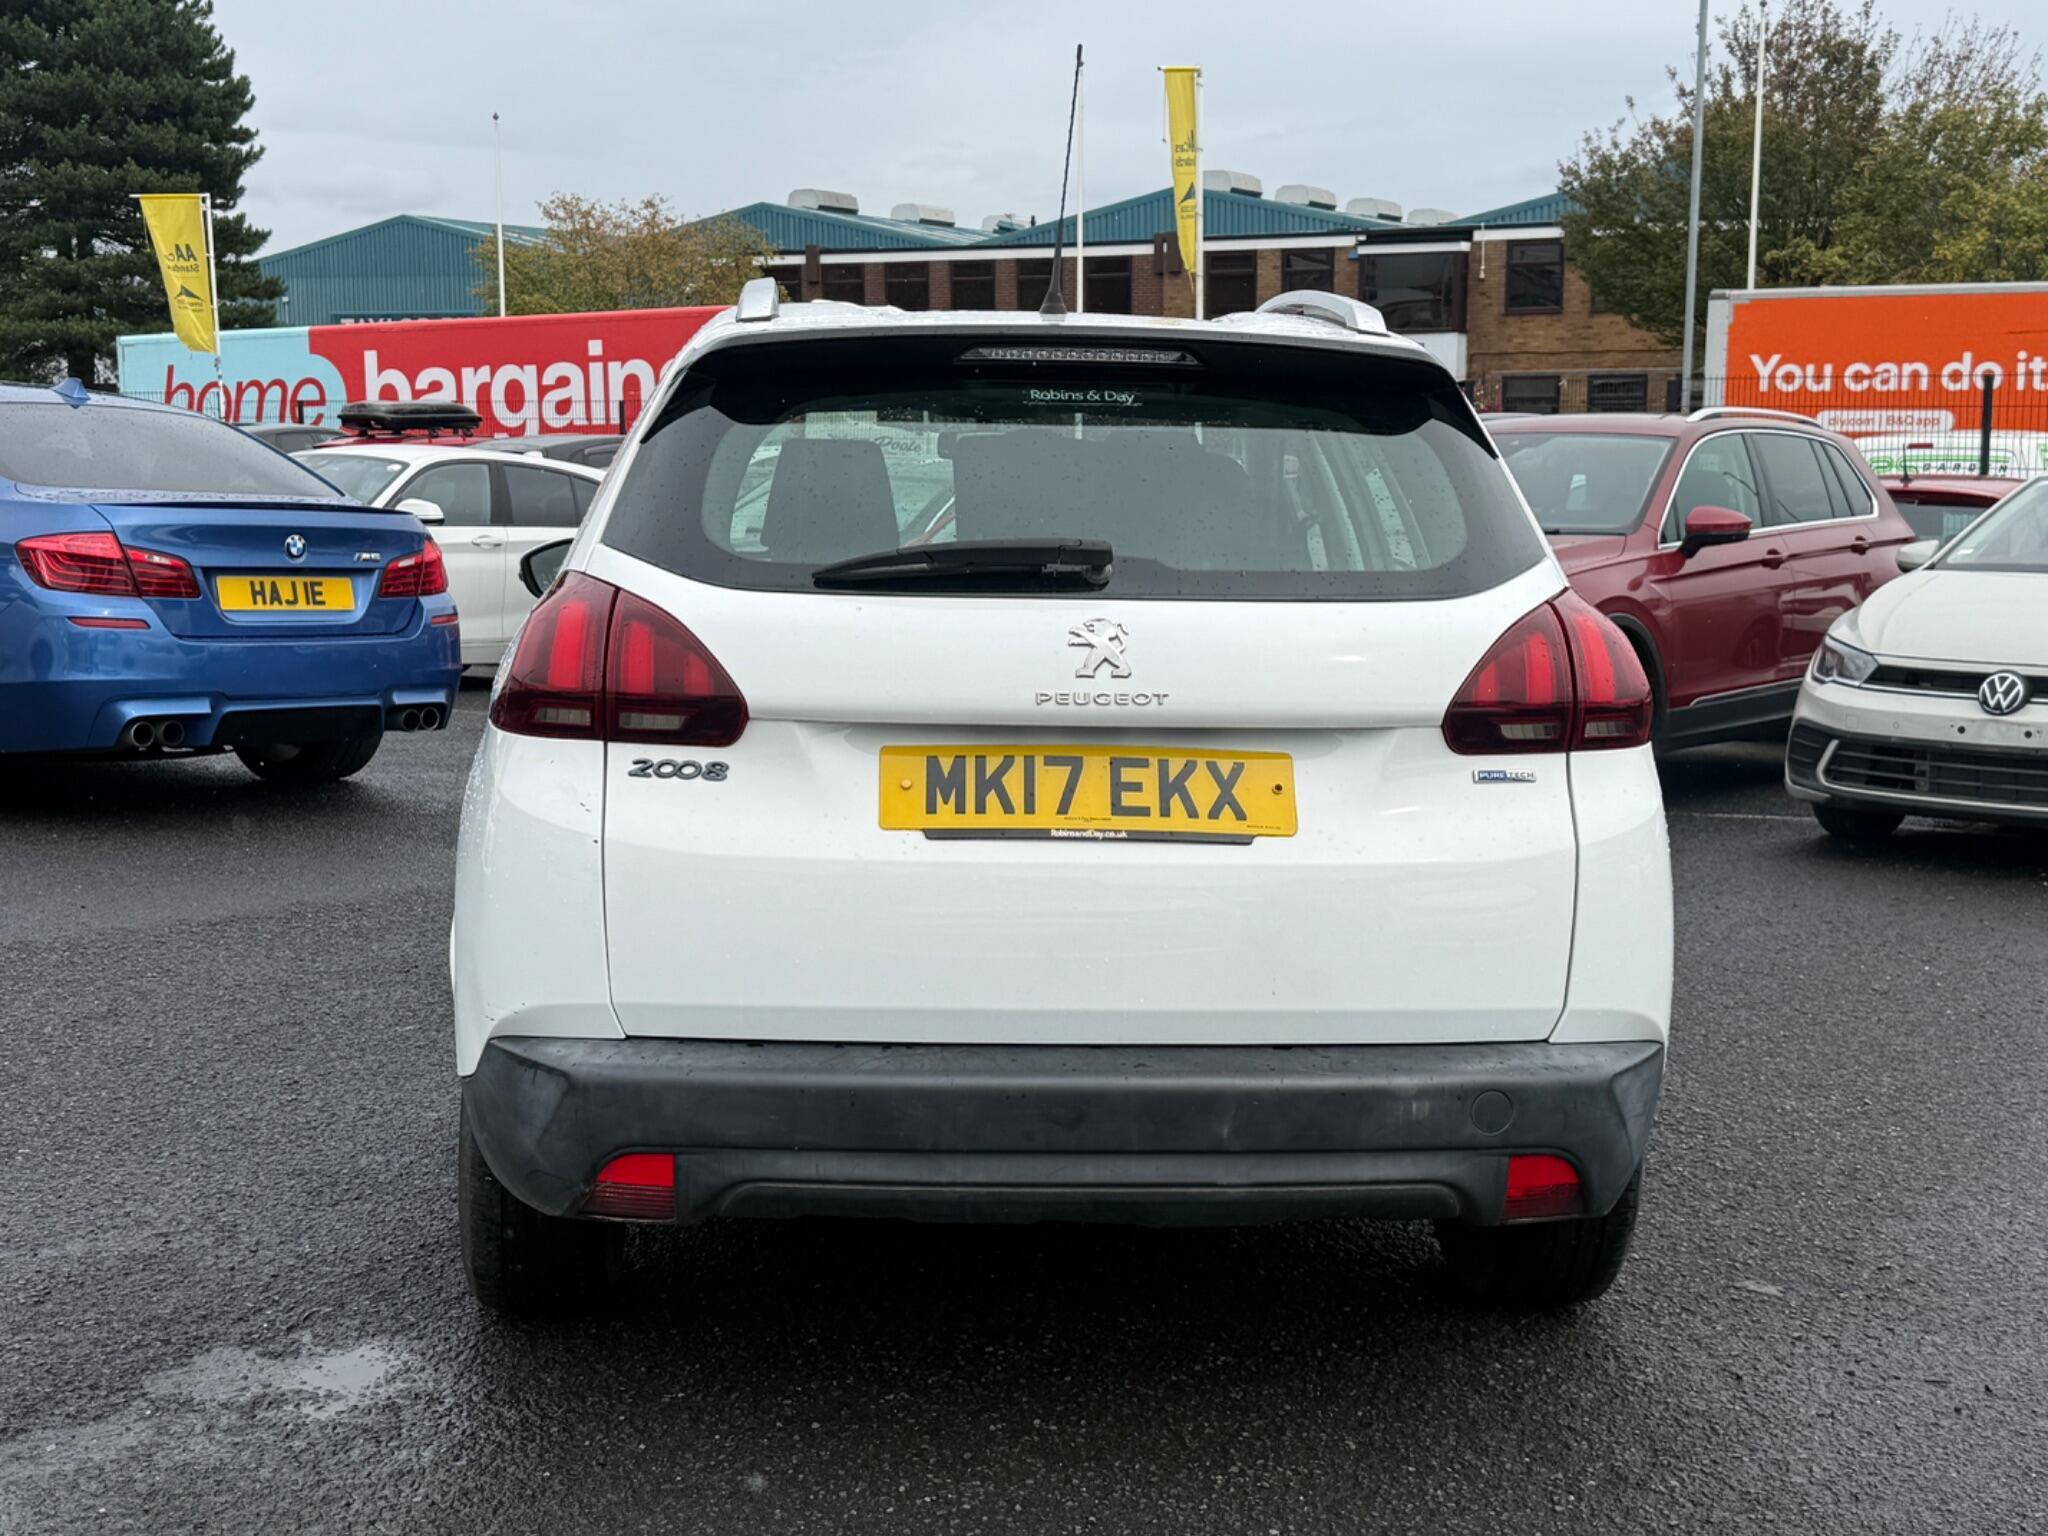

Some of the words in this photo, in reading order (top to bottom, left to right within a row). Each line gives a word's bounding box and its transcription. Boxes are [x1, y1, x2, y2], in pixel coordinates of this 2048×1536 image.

[1749, 353, 1832, 392] You
[1844, 361, 1929, 392] can
[1941, 350, 2004, 392] do
[164, 364, 326, 426] home
[363, 339, 684, 437] bargain
[1030, 389, 1083, 400] Robins
[1087, 390, 1100, 401] &
[1104, 390, 1136, 405] Day
[1916, 417, 1940, 429] app
[1035, 692, 1169, 707] PEUGEOT
[627, 758, 730, 782] 2008
[925, 754, 1084, 816] MK17
[1109, 756, 1248, 821] EKX
